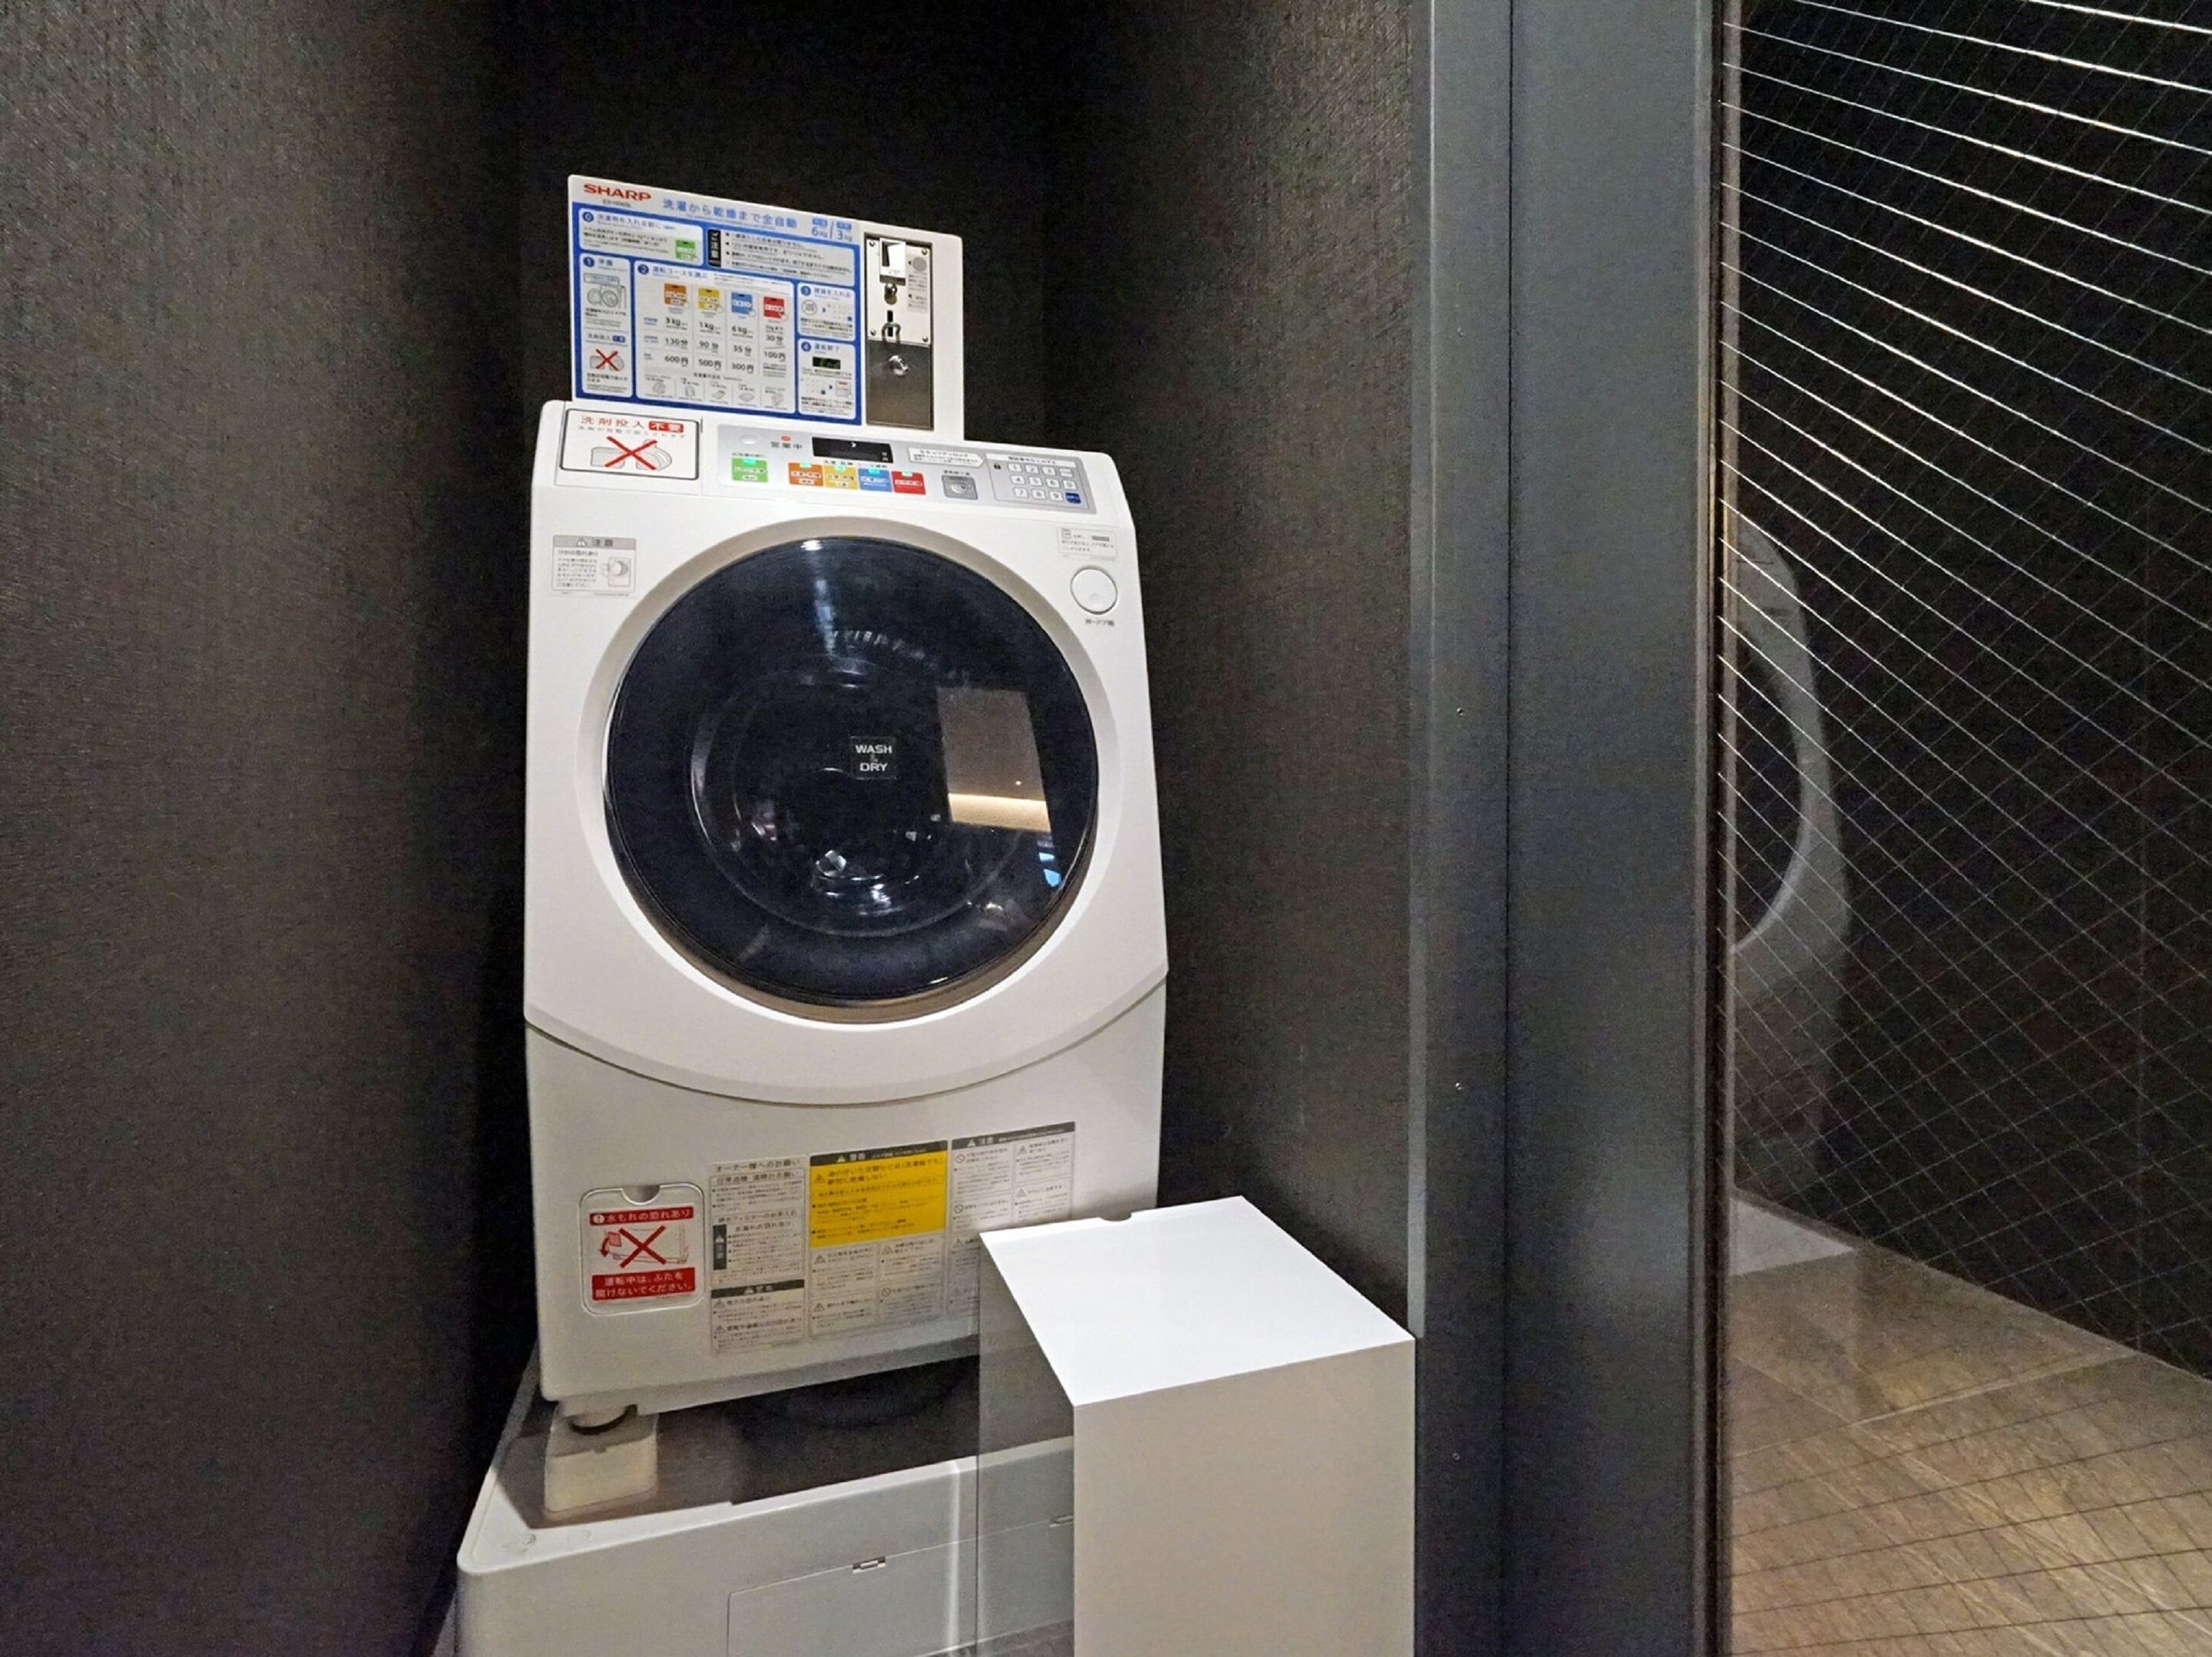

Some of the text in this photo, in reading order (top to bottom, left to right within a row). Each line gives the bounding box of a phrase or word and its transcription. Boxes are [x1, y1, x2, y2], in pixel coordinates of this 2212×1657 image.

[583, 183, 651, 201] SHARP
[663, 198, 797, 228] 洗濯から乾燥まで全自動
[581, 416, 683, 432] 洗剤投入 不要
[855, 744, 892, 753] WASH
[859, 762, 888, 772] DRY
[607, 1209, 690, 1223] 水もれの恐れあり
[604, 1272, 684, 1287] 運転中は、ふたを
